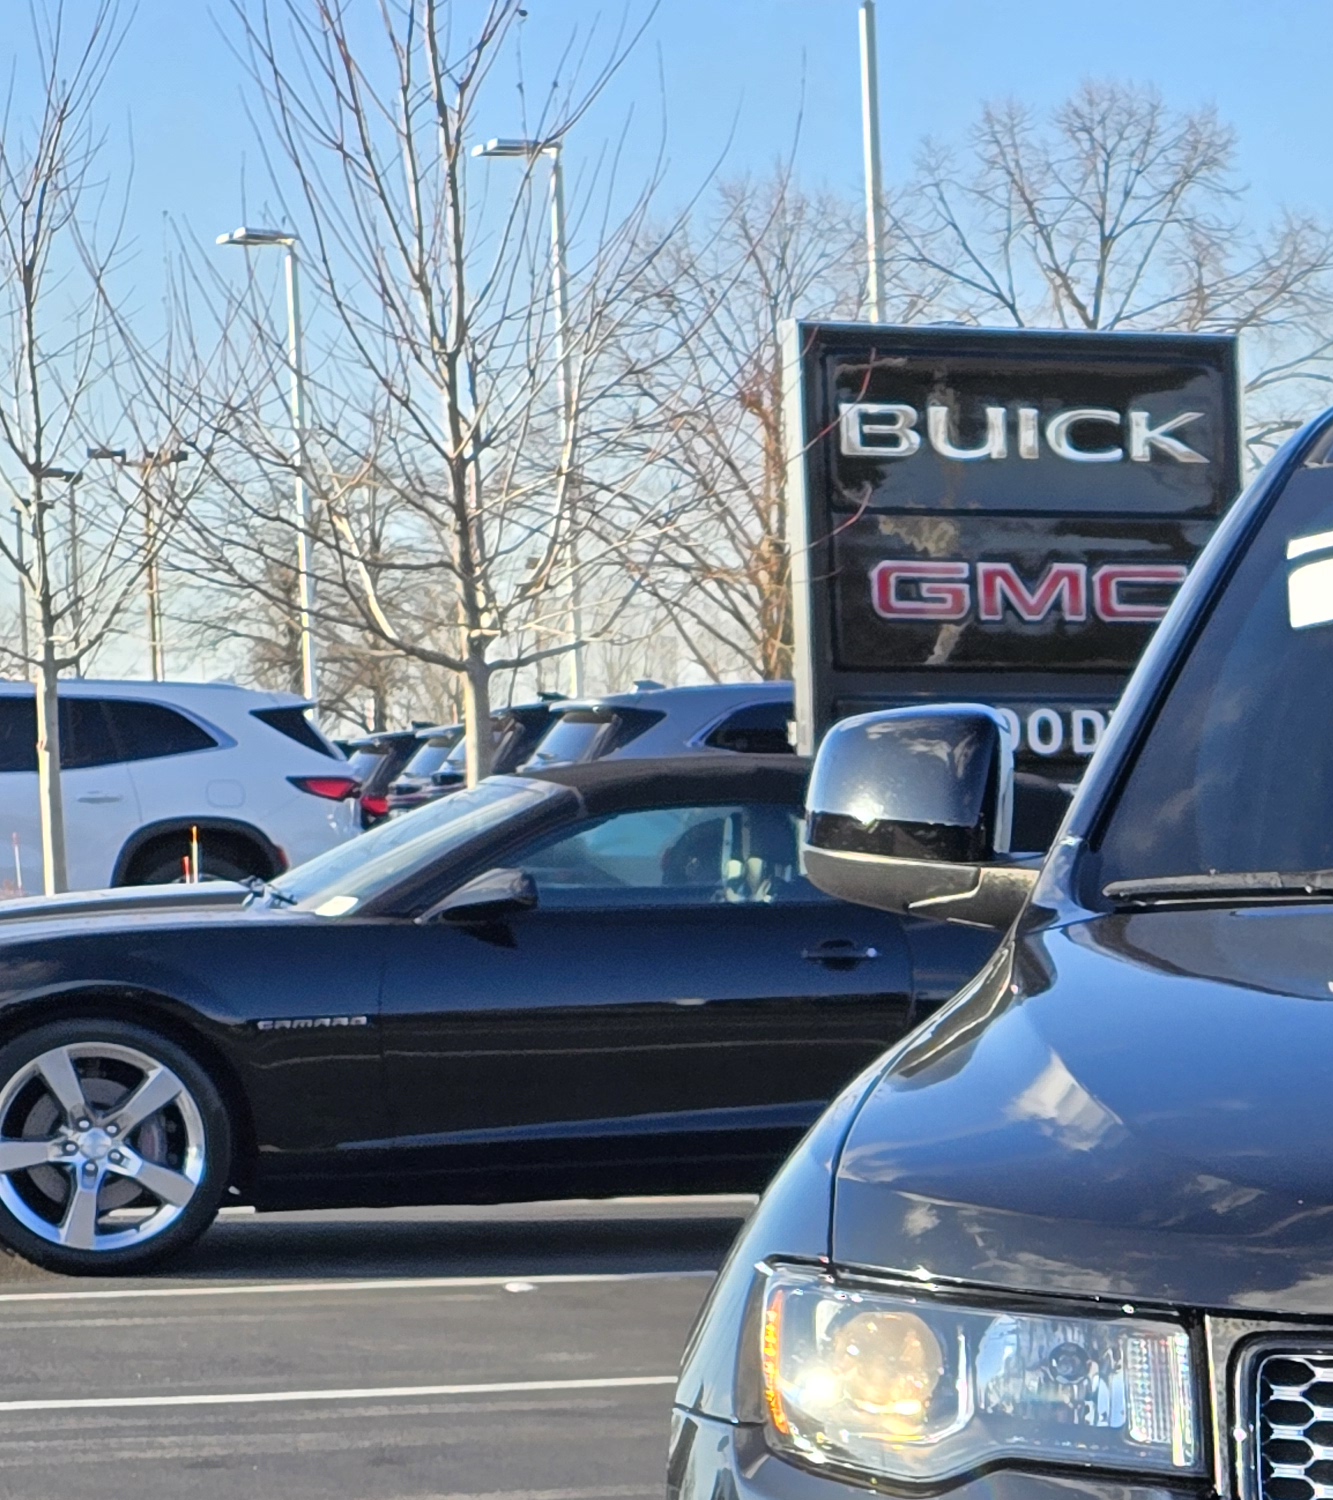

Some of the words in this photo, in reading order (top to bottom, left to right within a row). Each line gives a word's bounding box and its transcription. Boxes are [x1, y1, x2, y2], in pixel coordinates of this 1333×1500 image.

[839, 403, 1210, 463] BUICK
[871, 559, 1188, 622] GMC
[257, 1016, 367, 1030] CAMARO
